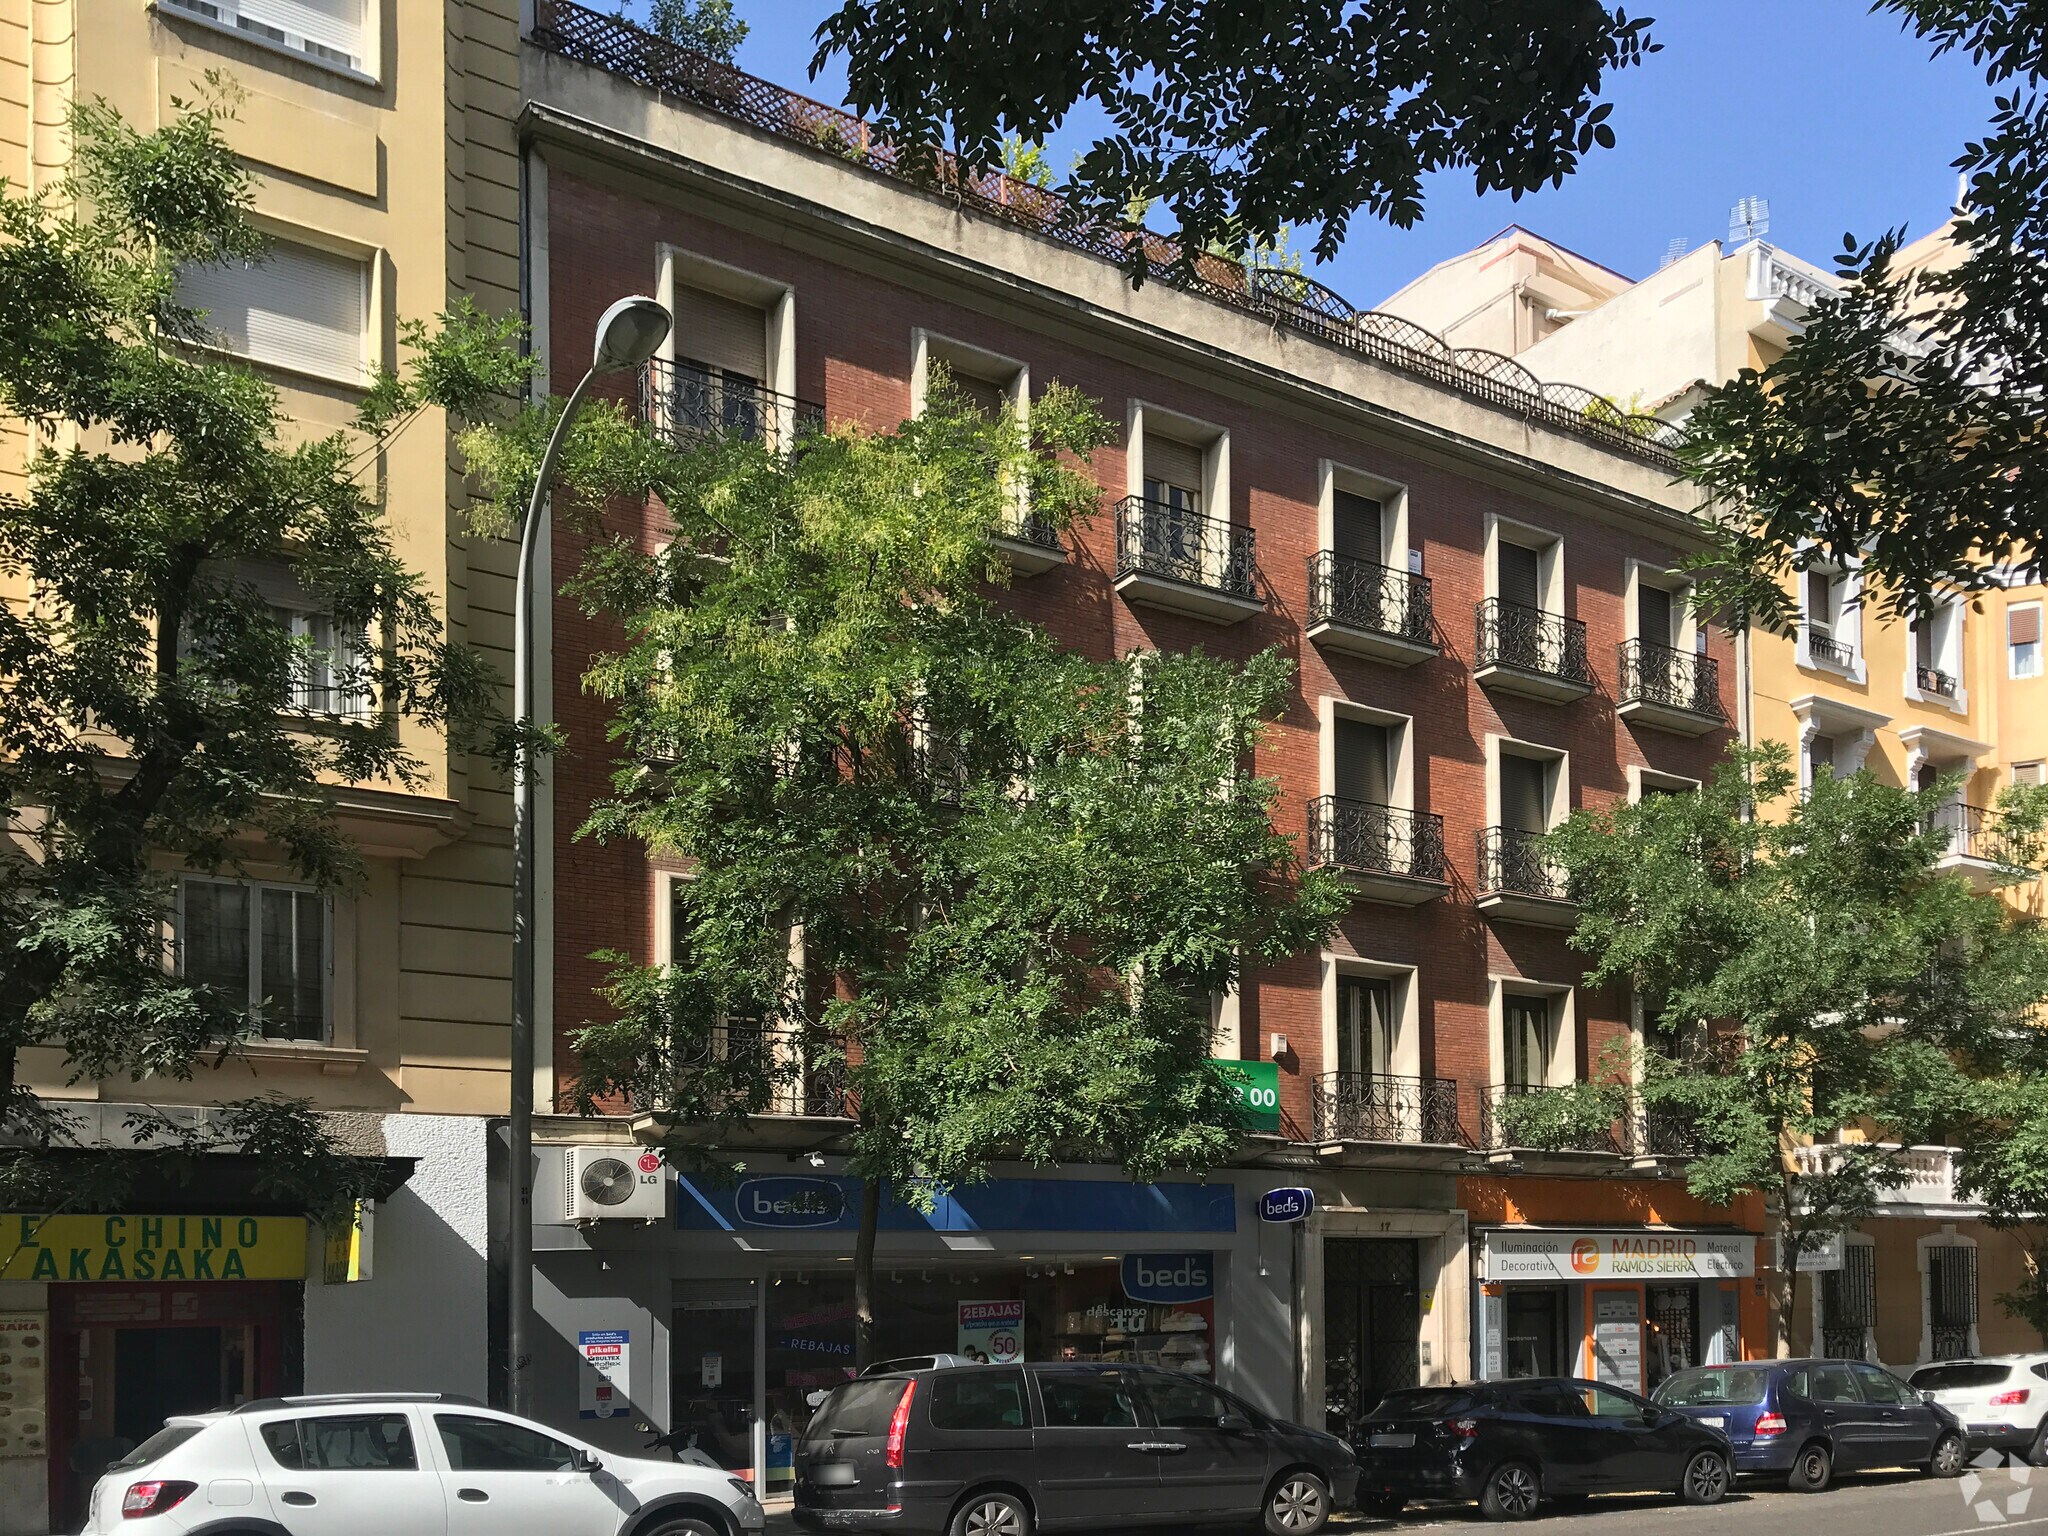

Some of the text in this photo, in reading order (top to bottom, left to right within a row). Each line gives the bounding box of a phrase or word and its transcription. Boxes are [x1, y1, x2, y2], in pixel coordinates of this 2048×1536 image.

[639, 1175, 657, 1185] LG
[1266, 1196, 1299, 1215] bed's
[105, 1216, 258, 1248] CHINO
[1500, 1240, 1559, 1253] Iluminación
[1612, 1239, 1696, 1260] MADRID
[1706, 1242, 1741, 1254] Material
[32, 1248, 247, 1280] AKASAKA
[1501, 1259, 1555, 1271] Decorativa
[1612, 1259, 1697, 1273] RAMOS SIERRA
[1706, 1258, 1744, 1271] Eléctrico
[1136, 1257, 1208, 1288] bed's
[1086, 1306, 1147, 1317] descanso
[589, 1346, 618, 1354] pikolin
[790, 1338, 850, 1355] REBAJAS
[993, 1336, 1016, 1355] 50
